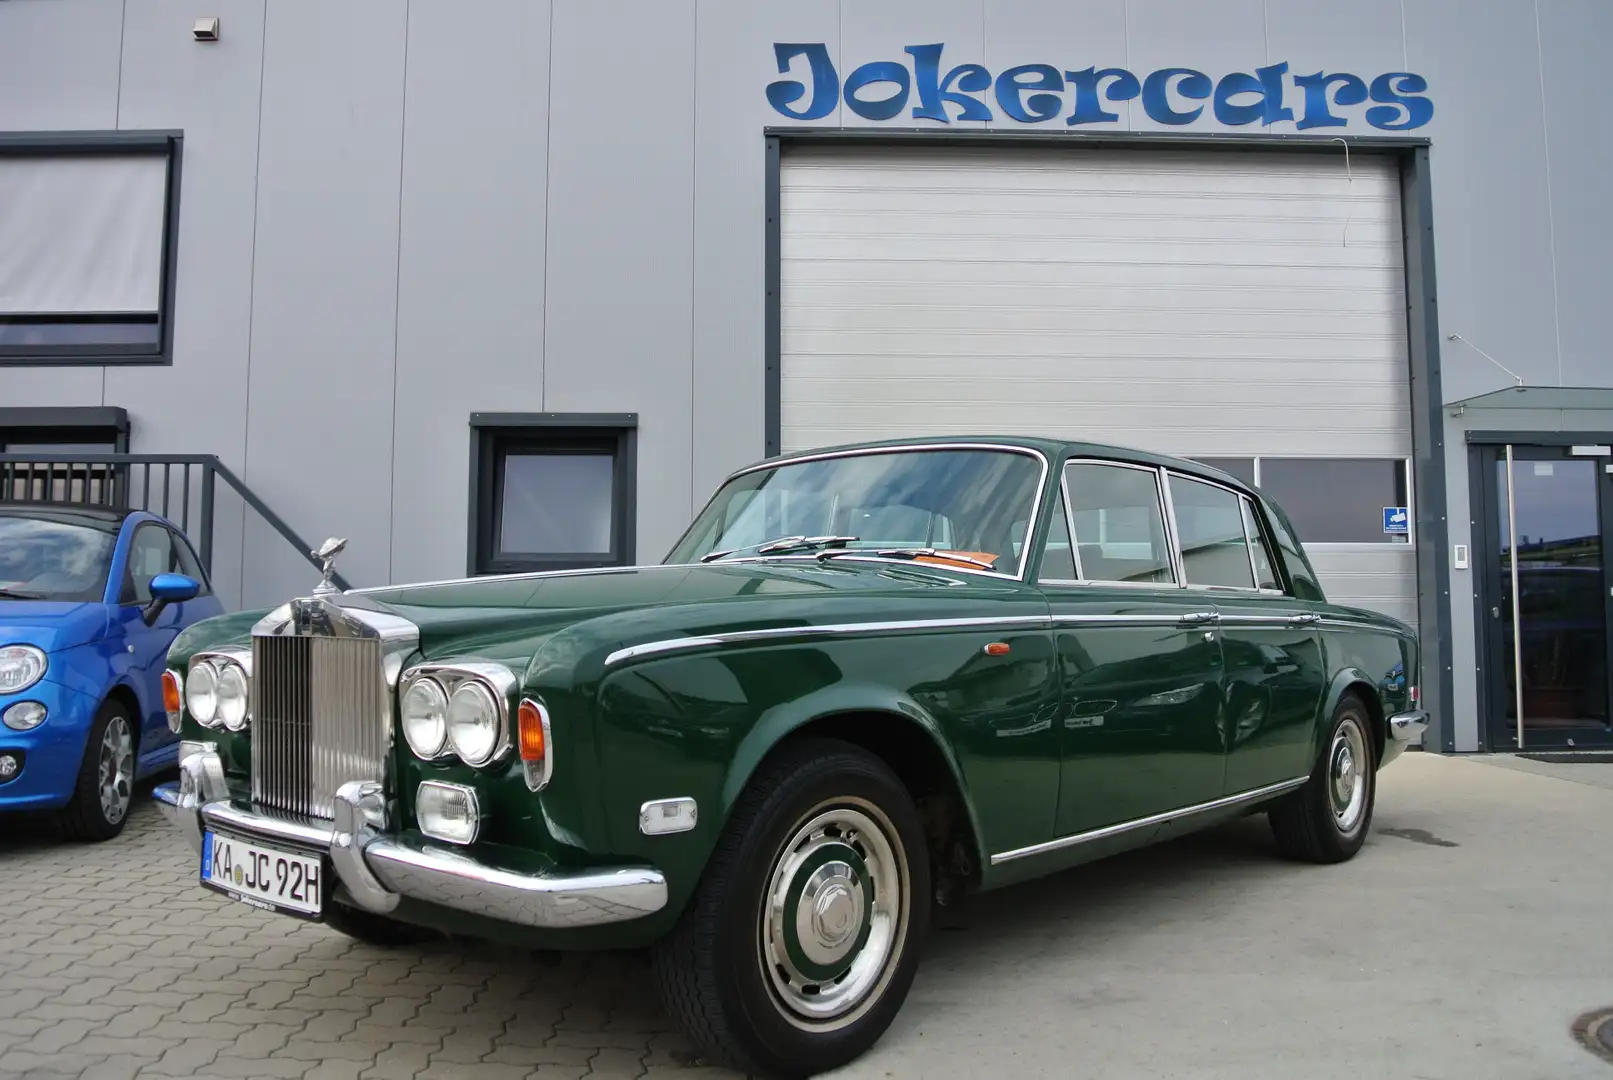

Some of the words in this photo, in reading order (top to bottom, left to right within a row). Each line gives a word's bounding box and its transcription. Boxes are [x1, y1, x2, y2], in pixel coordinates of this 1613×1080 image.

[766, 42, 1434, 130] Jokercars
[213, 840, 232, 882] KA
[245, 851, 270, 892] JC
[276, 858, 319, 905] 92H
